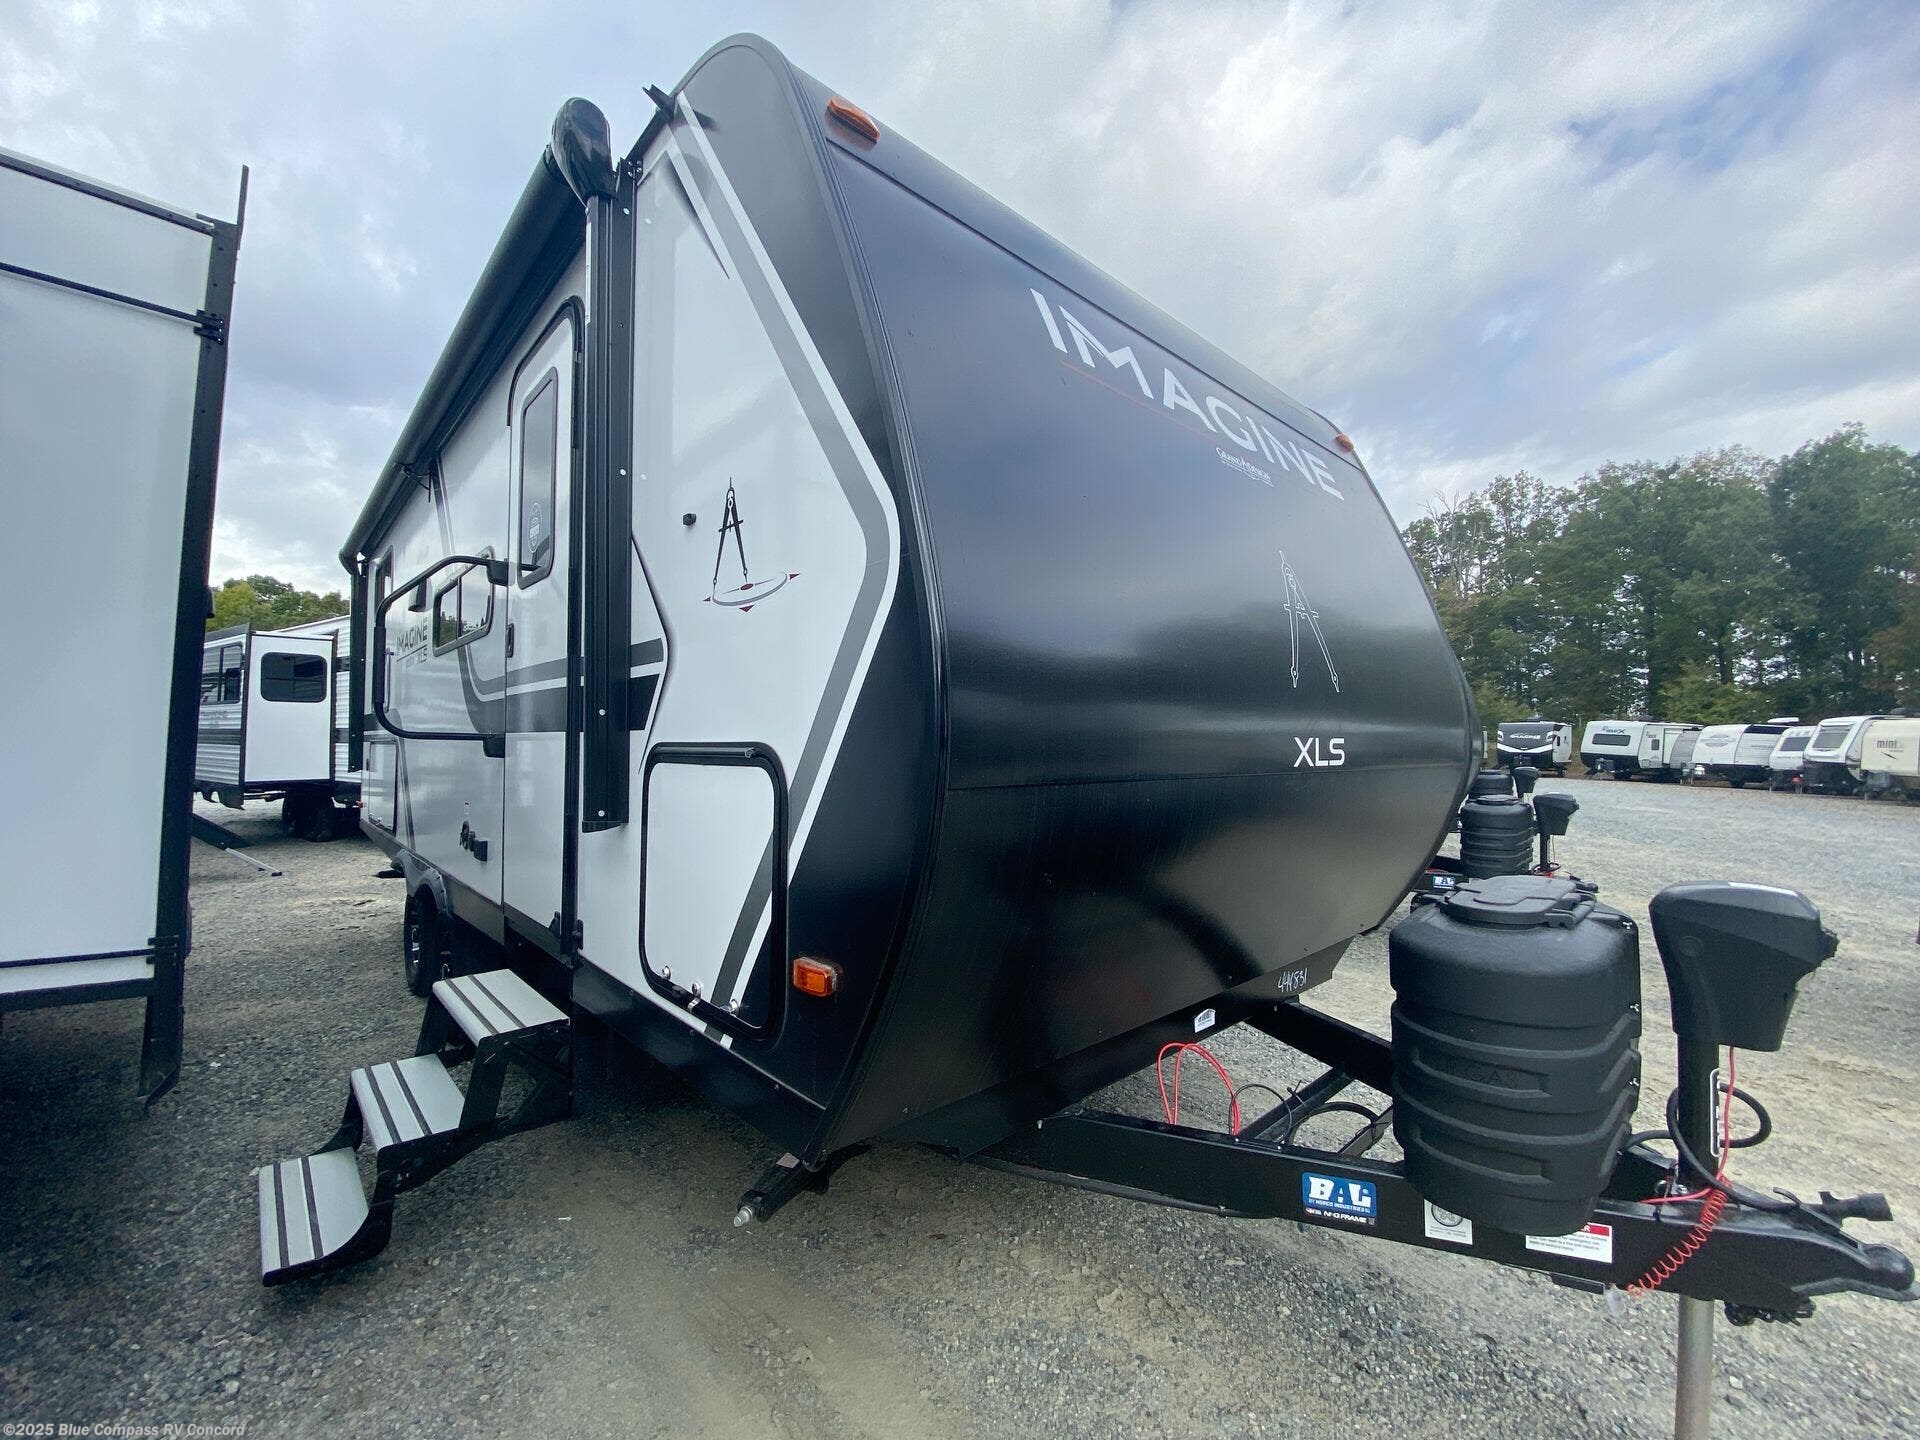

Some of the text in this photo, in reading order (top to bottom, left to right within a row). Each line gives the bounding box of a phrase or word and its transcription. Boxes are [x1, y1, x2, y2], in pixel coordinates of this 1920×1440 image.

[1030, 287, 1345, 501] IMAGINE
[1293, 736, 1346, 767] XLS
[1308, 1176, 1372, 1208] BAL
